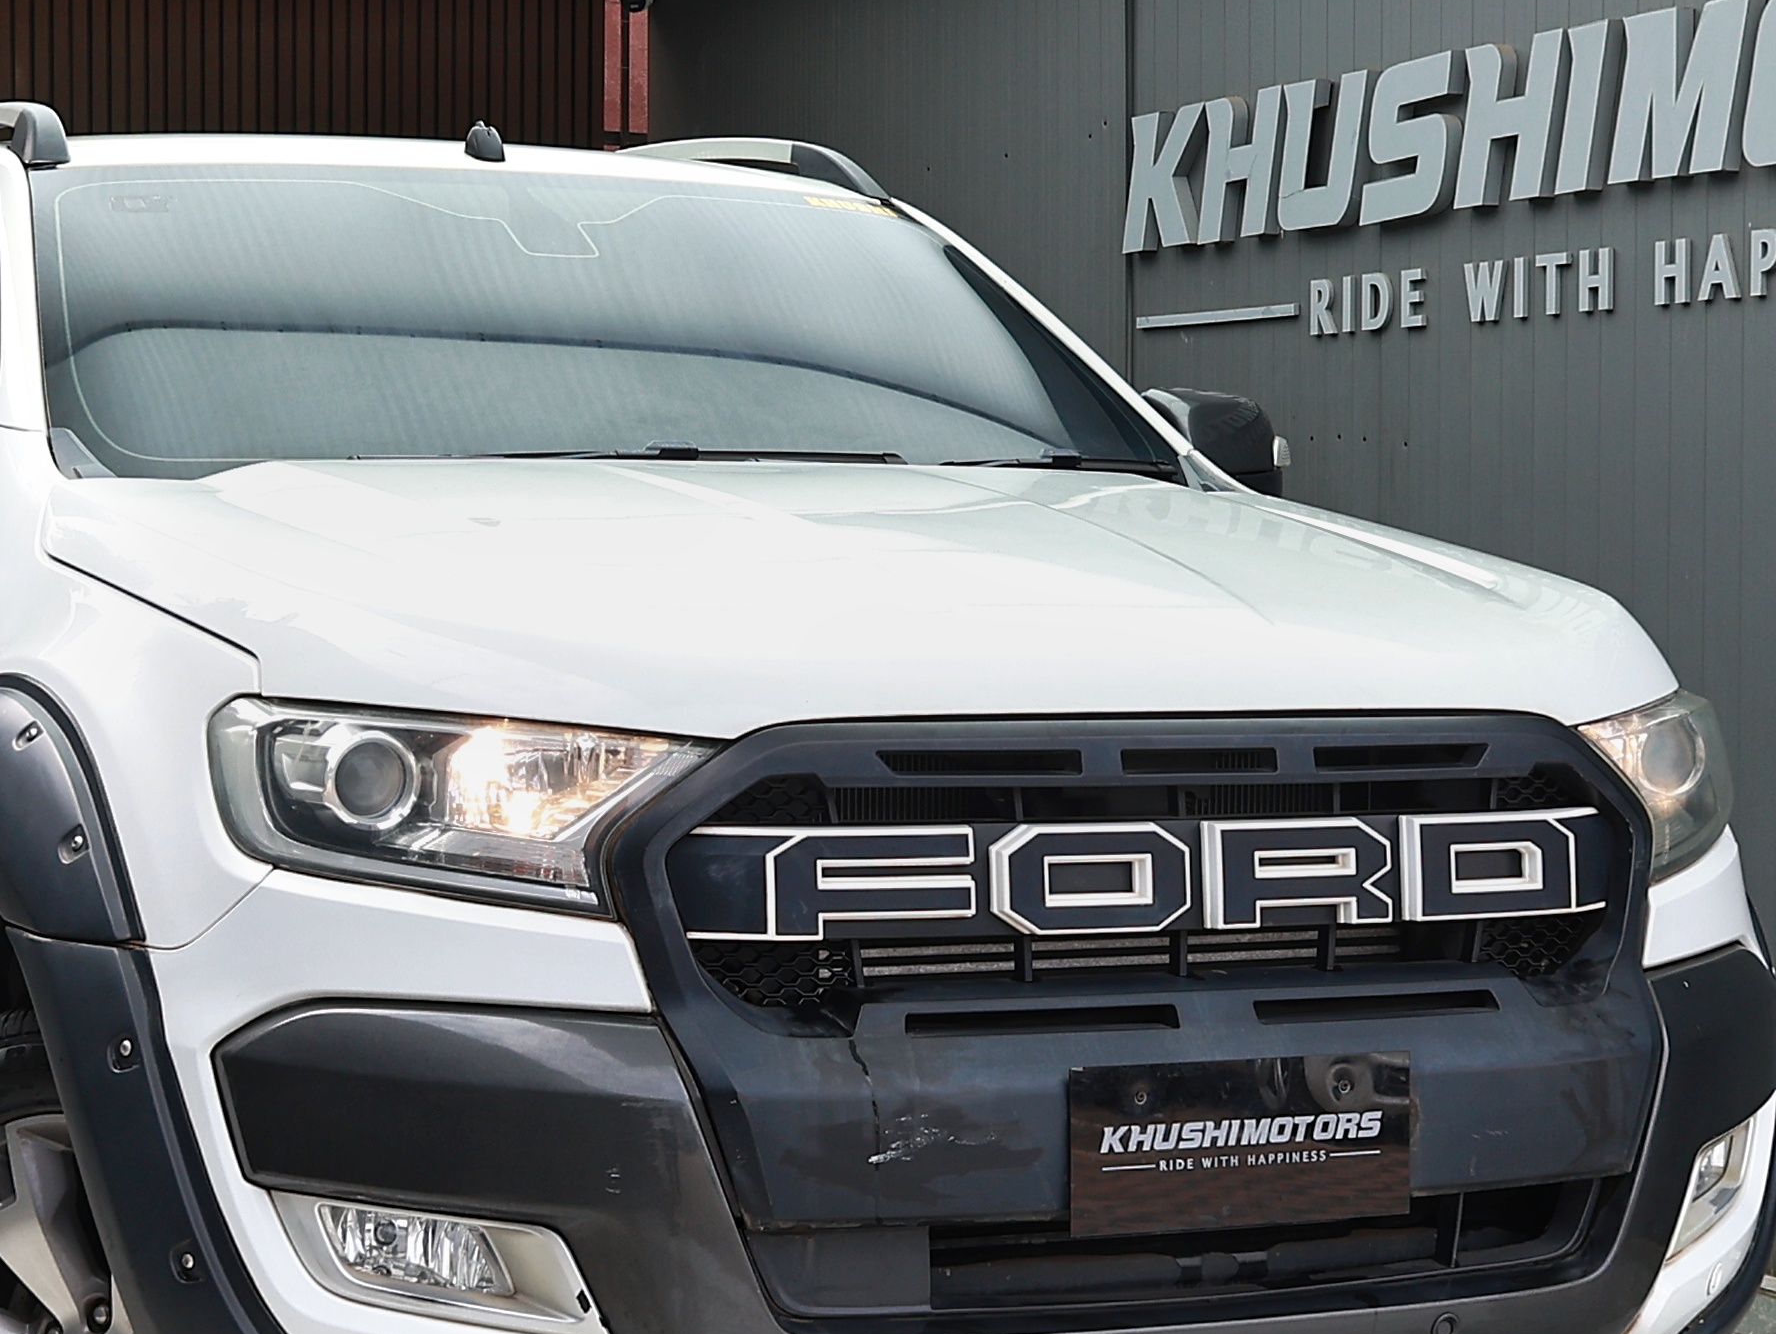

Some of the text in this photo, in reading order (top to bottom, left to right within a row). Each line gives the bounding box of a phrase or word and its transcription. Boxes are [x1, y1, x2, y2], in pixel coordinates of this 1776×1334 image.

[1308, 267, 1425, 336] RIDE
[1465, 247, 1616, 325] WITH
[765, 811, 1577, 941] FORD
[1100, 1110, 1383, 1154] KHUSHIMOTORS
[1159, 1150, 1327, 1172] RIDE WITH HAPPINESS
